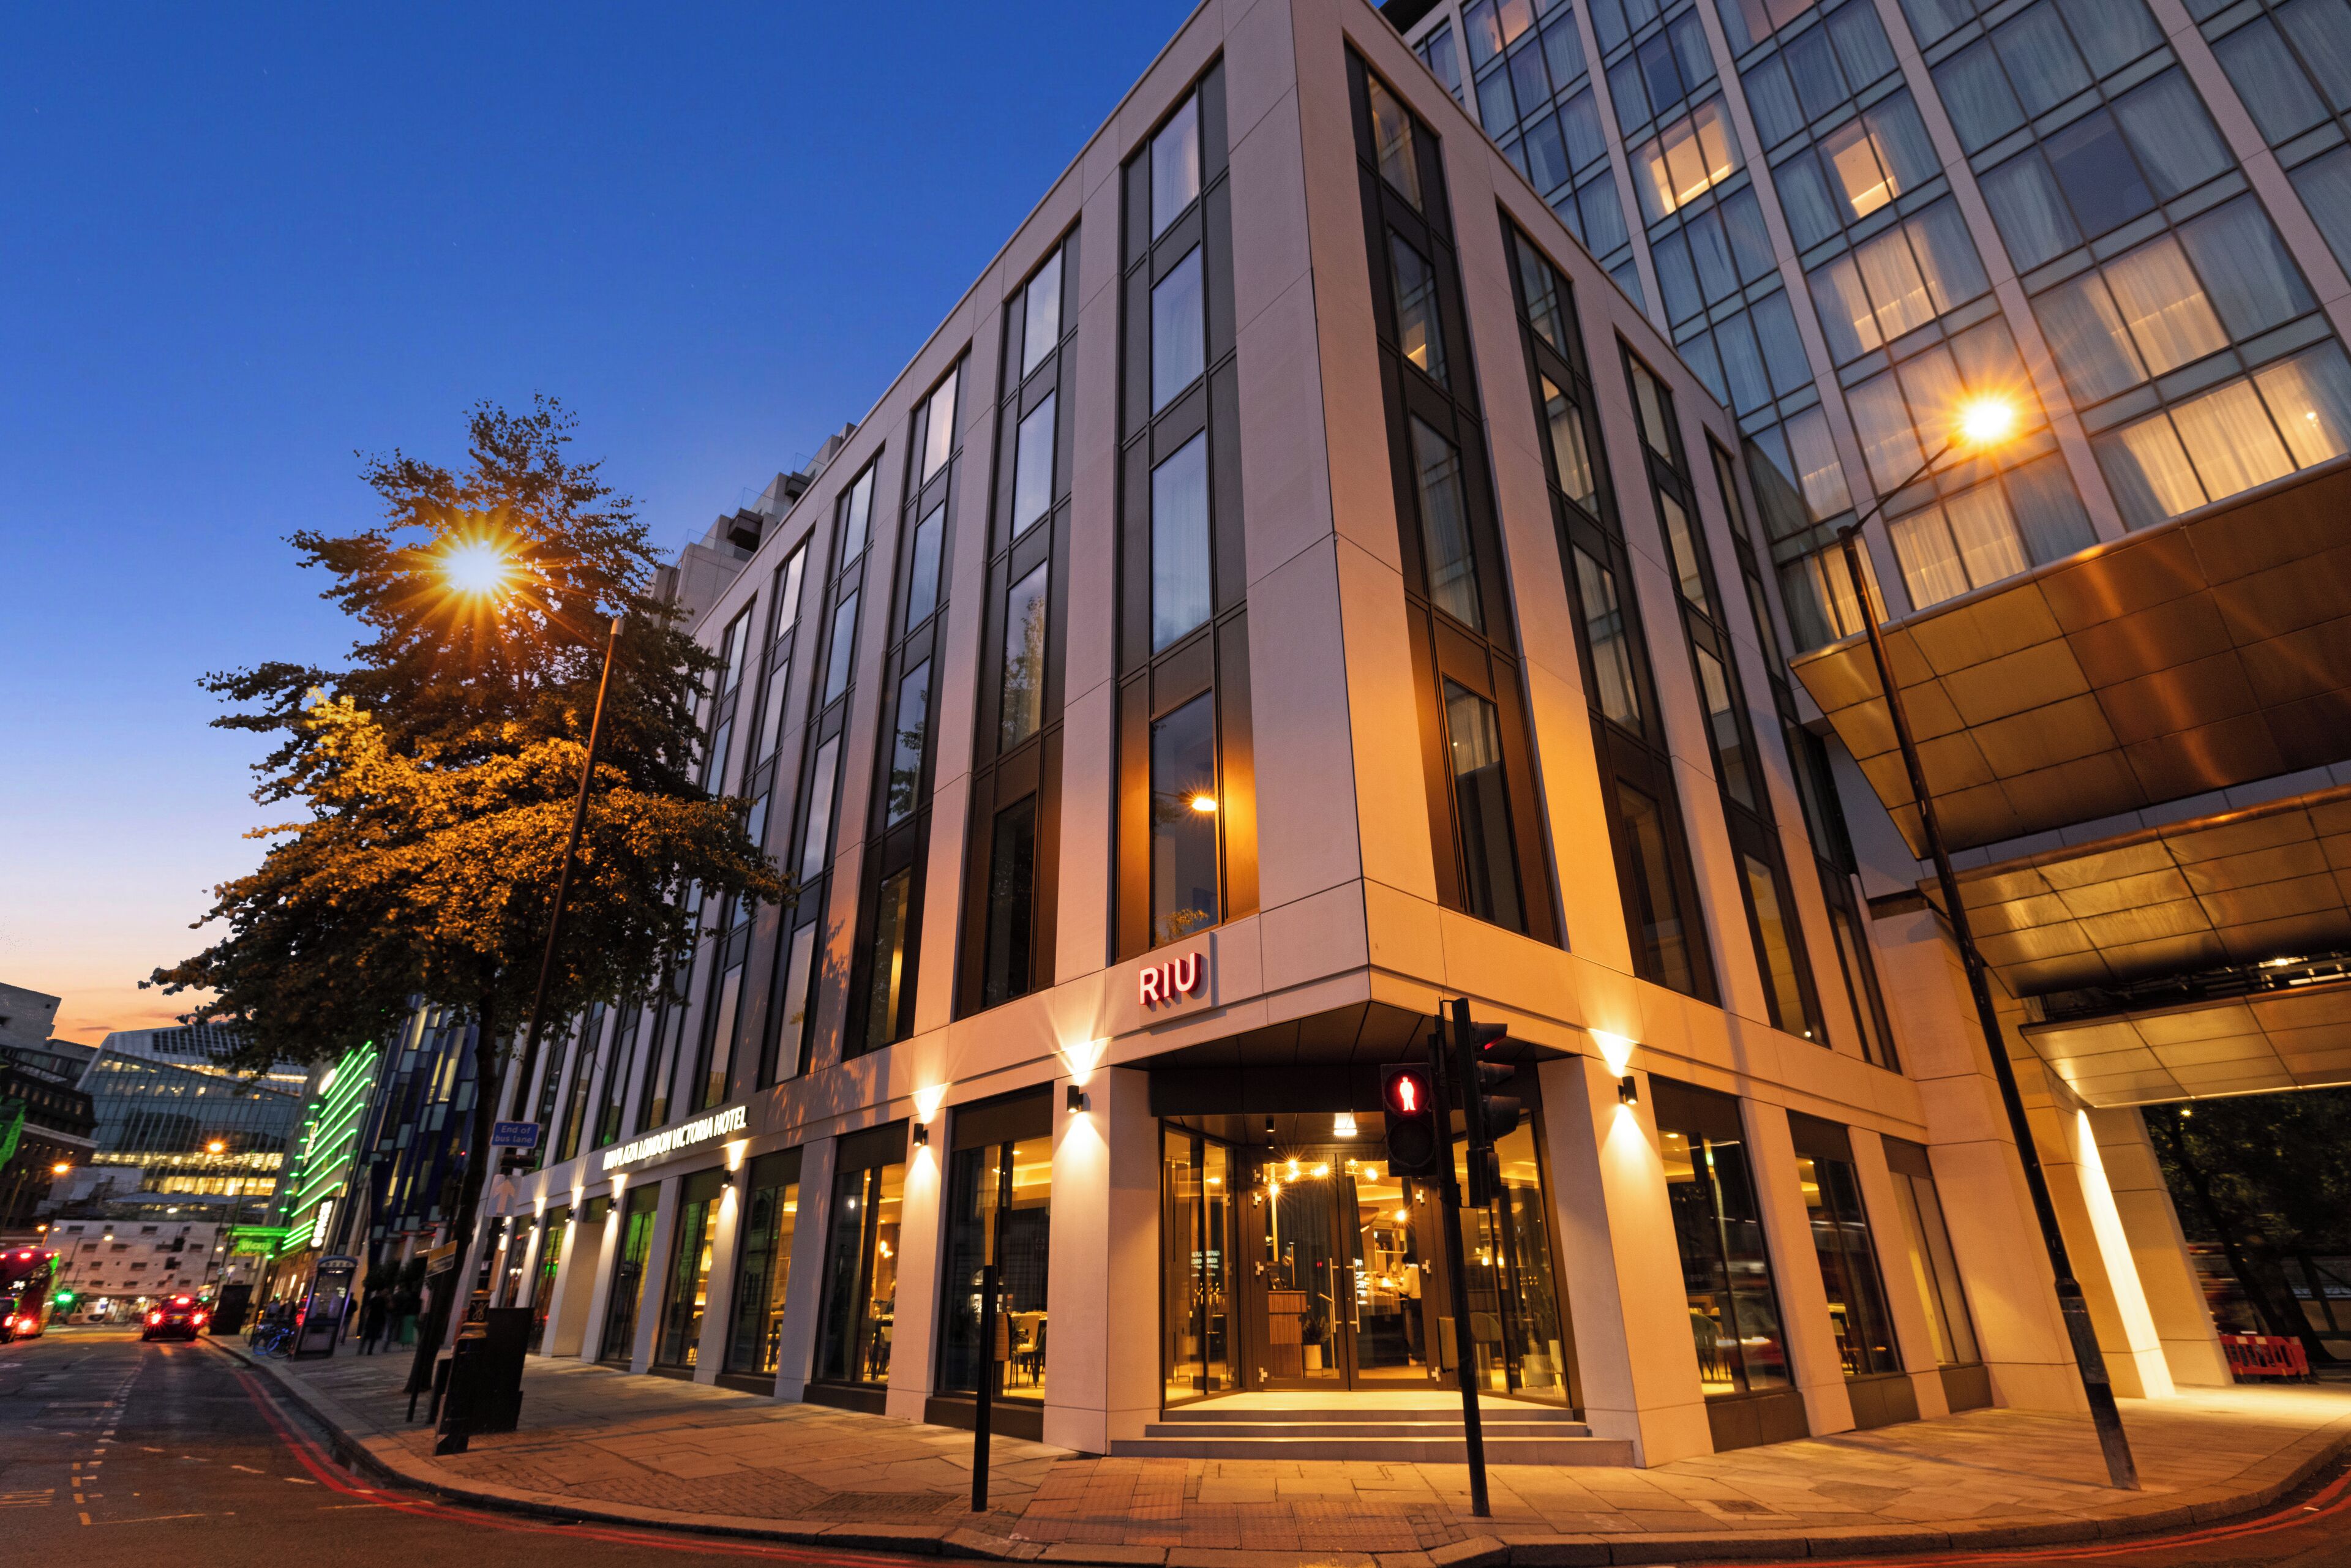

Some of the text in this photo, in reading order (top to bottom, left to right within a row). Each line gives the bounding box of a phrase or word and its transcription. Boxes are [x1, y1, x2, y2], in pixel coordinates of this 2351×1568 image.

[1139, 952, 1200, 1005] RIU
[614, 1142, 639, 1166] PLAZA
[637, 1130, 673, 1160] LONDON
[672, 1117, 713, 1149] VICTORIA
[713, 1105, 747, 1136] HOTEL
